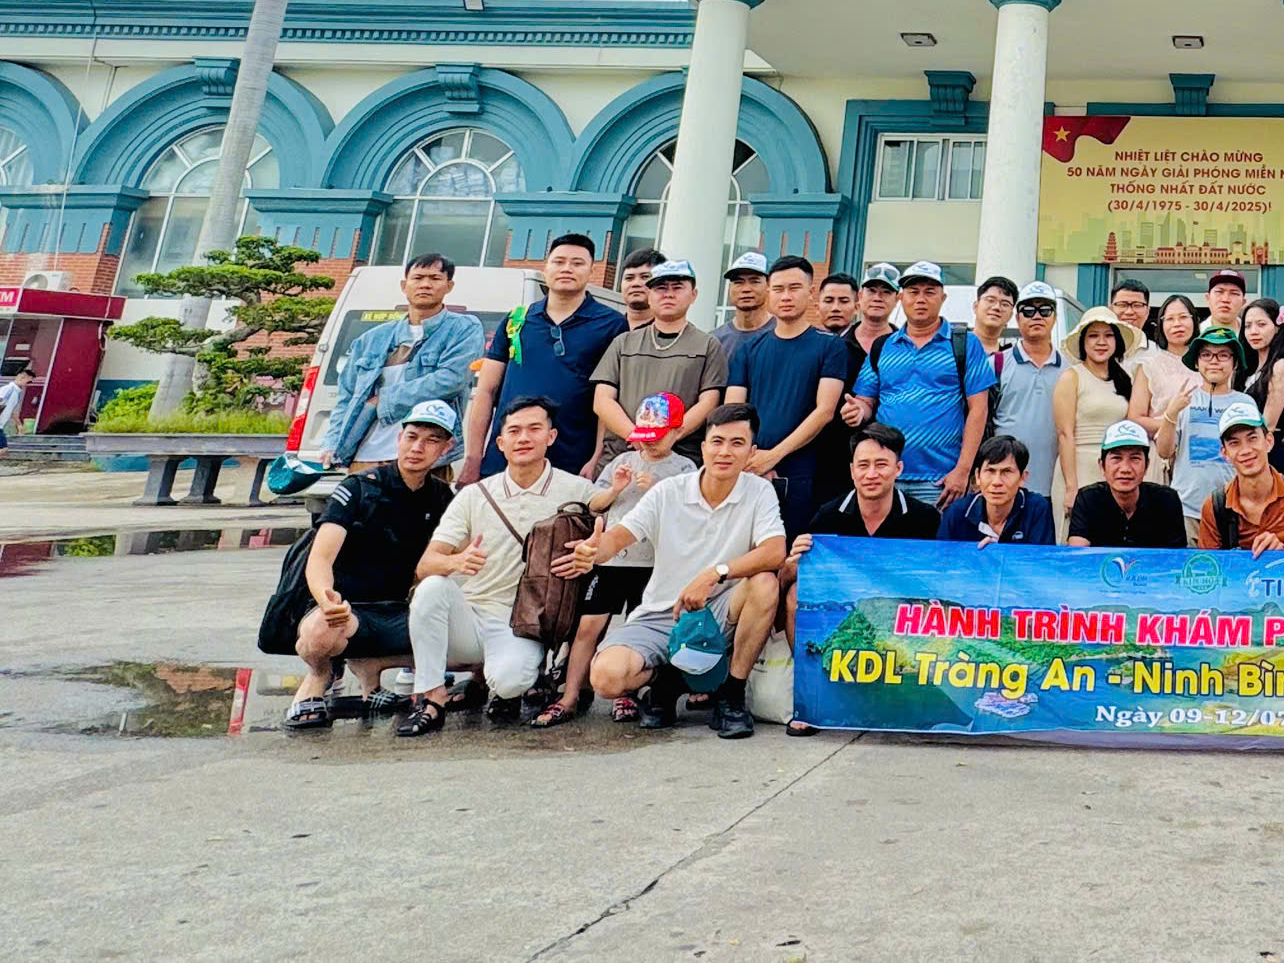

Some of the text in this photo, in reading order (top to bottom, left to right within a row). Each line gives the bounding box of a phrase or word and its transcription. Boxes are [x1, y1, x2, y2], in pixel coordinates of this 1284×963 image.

[1114, 148, 1264, 164] NHIỆT LIỆT CHÀO MỪNG
[1067, 167, 1083, 178] 50
[1086, 164, 1116, 177] NĂM
[1120, 164, 1157, 178] NGÀY
[1161, 164, 1189, 178] GIẢI
[1193, 165, 1241, 179] PHÓNG
[1245, 164, 1276, 179] MIỀN
[1110, 179, 1267, 195] THỐNG NHẤT ĐẤT NƯỚC
[1107, 199, 1182, 213] (30/4/1975
[1193, 200, 1272, 215] 30/4/2025)!
[894, 599, 1001, 638] HÀNH
[1012, 604, 1127, 645] TRÌNH
[1136, 602, 1253, 647] KHÁM
[828, 649, 902, 686] KDL
[916, 651, 1030, 701] Tràng
[1040, 657, 1096, 692] An
[1105, 671, 1122, 685] -
[1132, 660, 1224, 697] Ninh
[1094, 704, 1163, 727] Ngày
